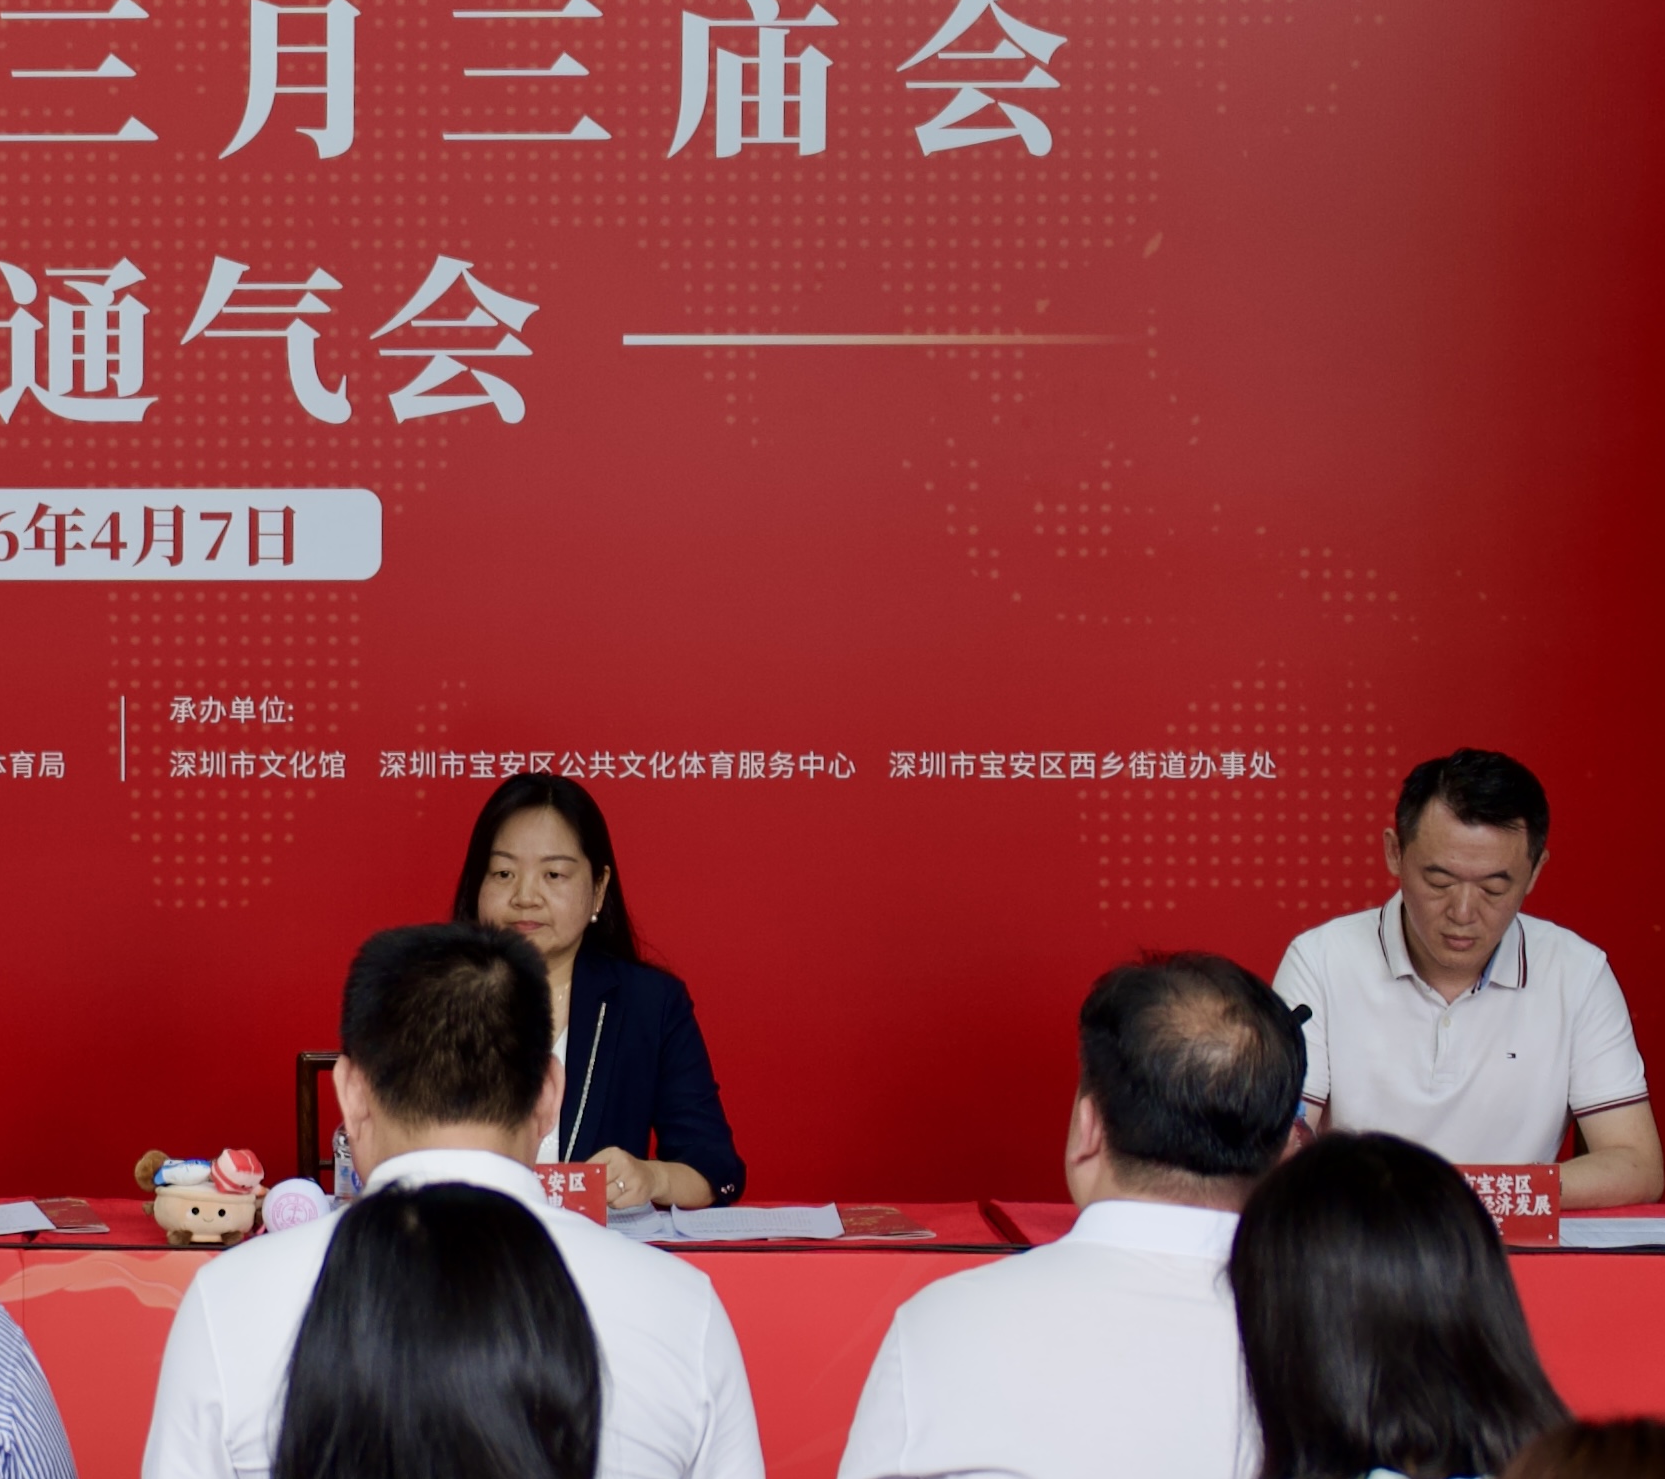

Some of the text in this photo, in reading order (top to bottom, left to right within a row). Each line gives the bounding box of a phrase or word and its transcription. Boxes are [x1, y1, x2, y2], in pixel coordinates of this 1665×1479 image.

[169, 750, 1278, 781] 深圳市文化馆 深圳市宝安区公共文化体育服务中心 深圳市宝安区西乡街道办事处
